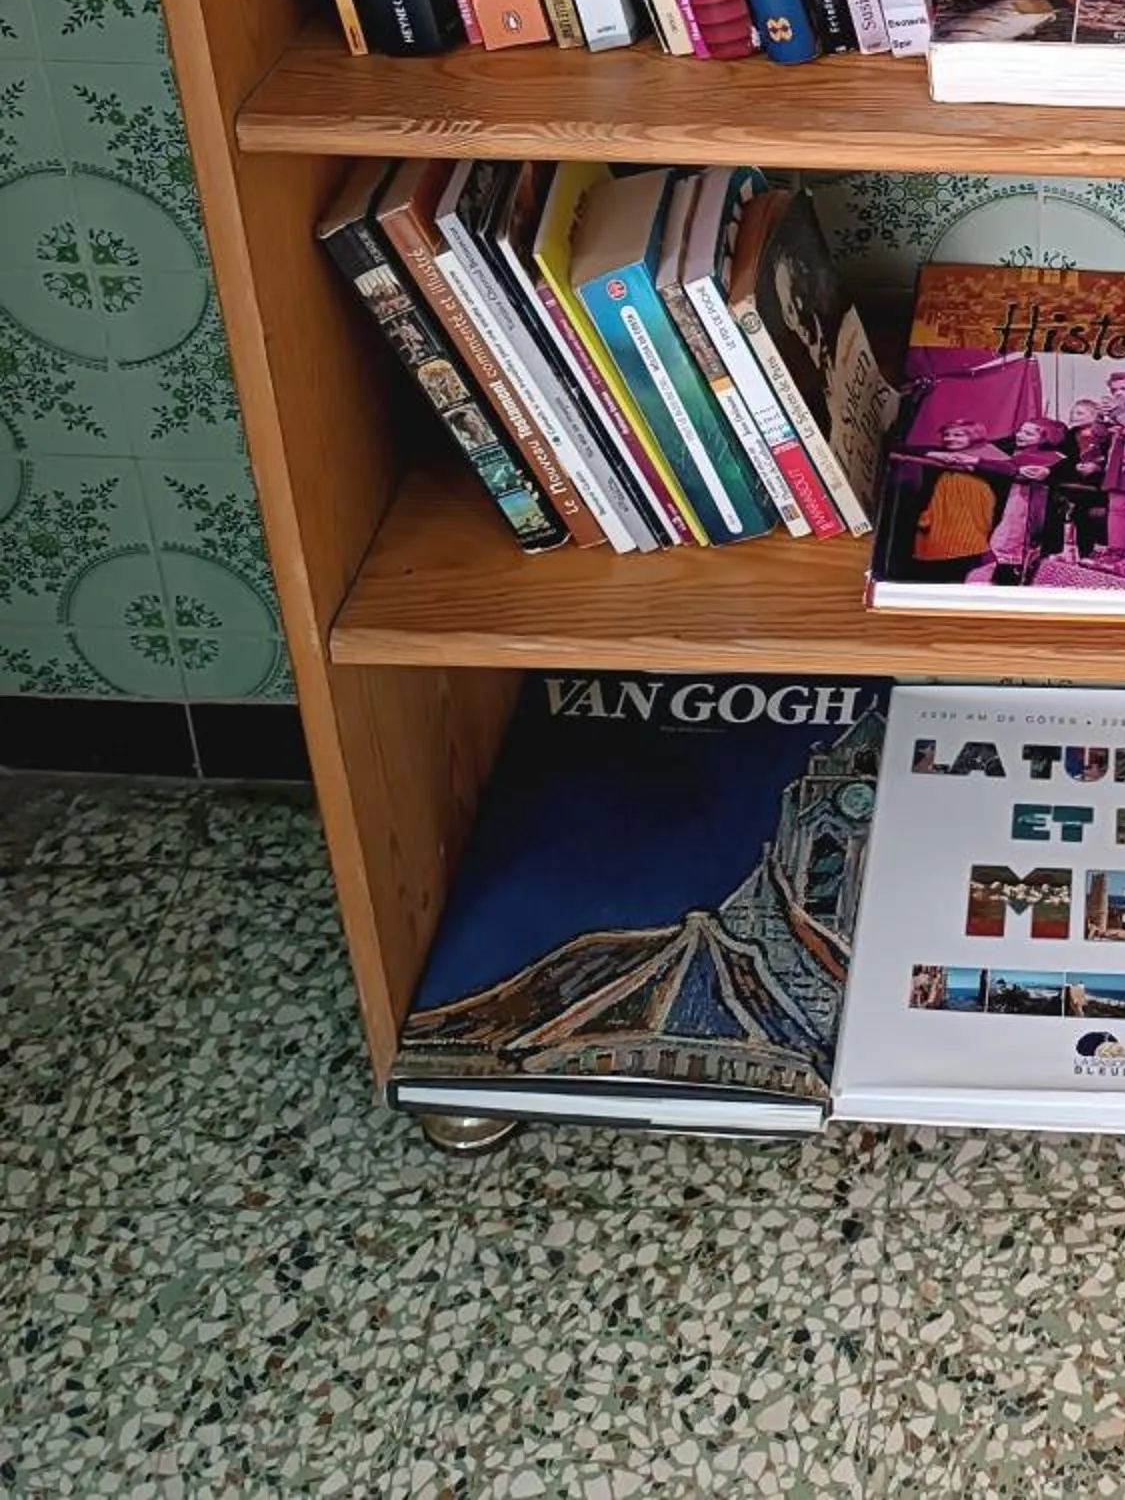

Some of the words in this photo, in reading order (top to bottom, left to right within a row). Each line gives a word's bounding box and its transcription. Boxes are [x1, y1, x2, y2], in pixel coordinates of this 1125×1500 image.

[406, 244, 448, 299] illustré
[439, 295, 457, 312] et
[449, 311, 498, 381] commenté
[765, 355, 785, 380] Paris
[776, 377, 791, 393] de
[489, 377, 532, 440] Testament
[804, 426, 816, 438] Le
[524, 436, 568, 498] Nouveau
[562, 499, 579, 517] Le
[787, 464, 828, 526] MARABOUT
[544, 678, 662, 722] VAN
[670, 682, 862, 726] GOGH
[911, 739, 1006, 777] LA
[1011, 803, 1094, 842] ET
